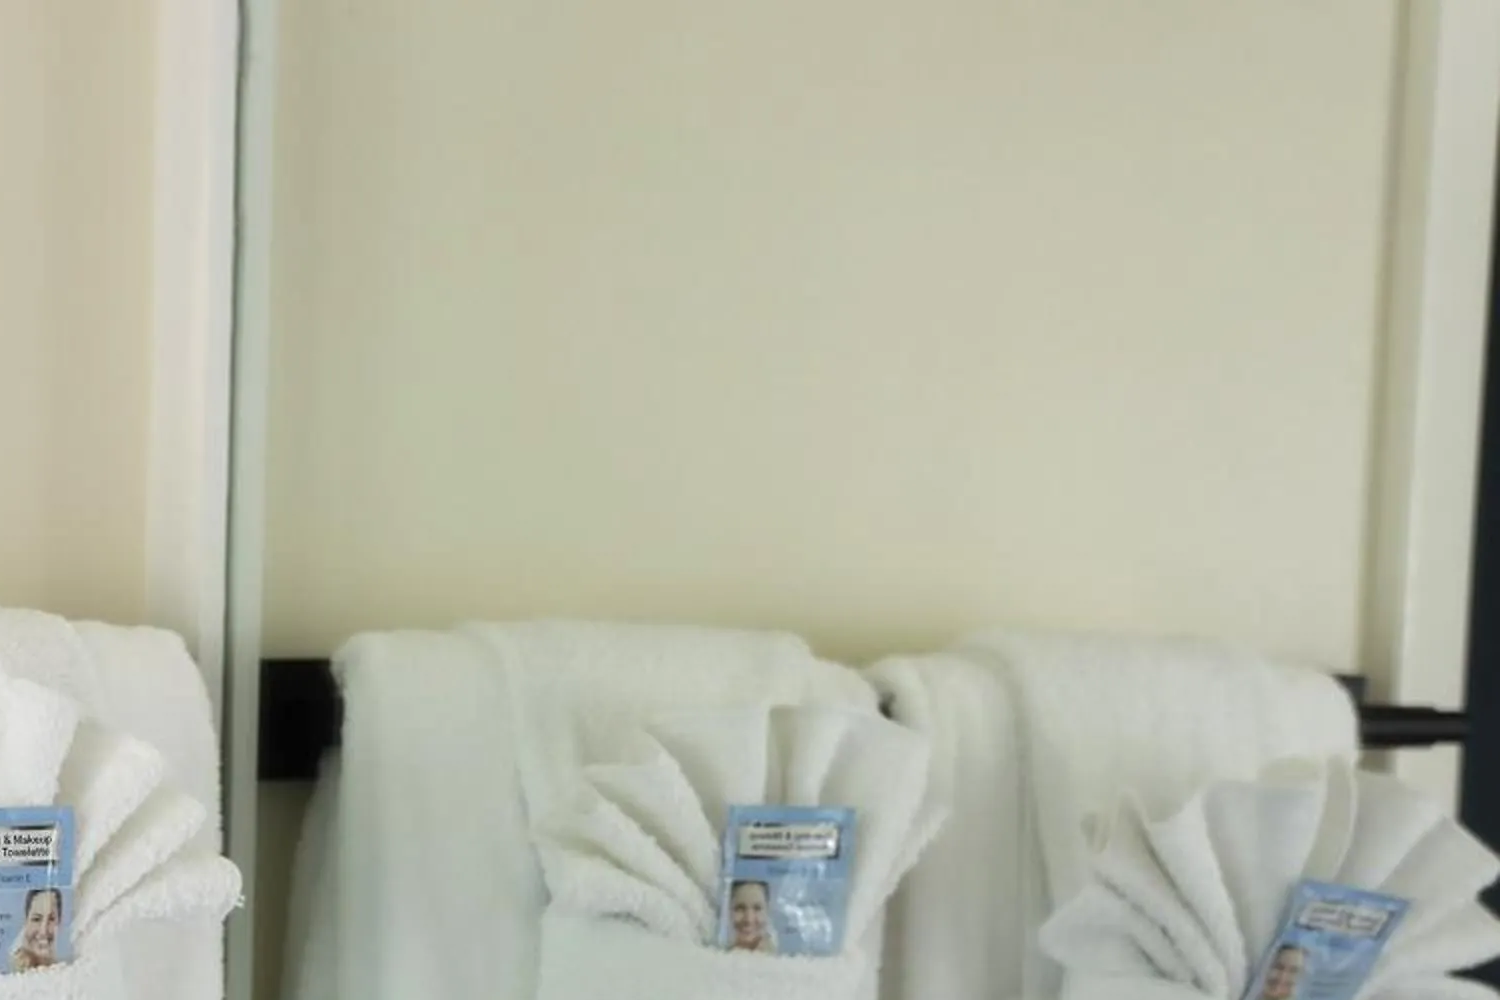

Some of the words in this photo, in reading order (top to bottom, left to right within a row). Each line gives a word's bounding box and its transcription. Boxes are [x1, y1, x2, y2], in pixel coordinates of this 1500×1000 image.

[3, 835, 11, 844] &
[14, 835, 52, 846] Makeup
[2, 847, 50, 856] Towelette
